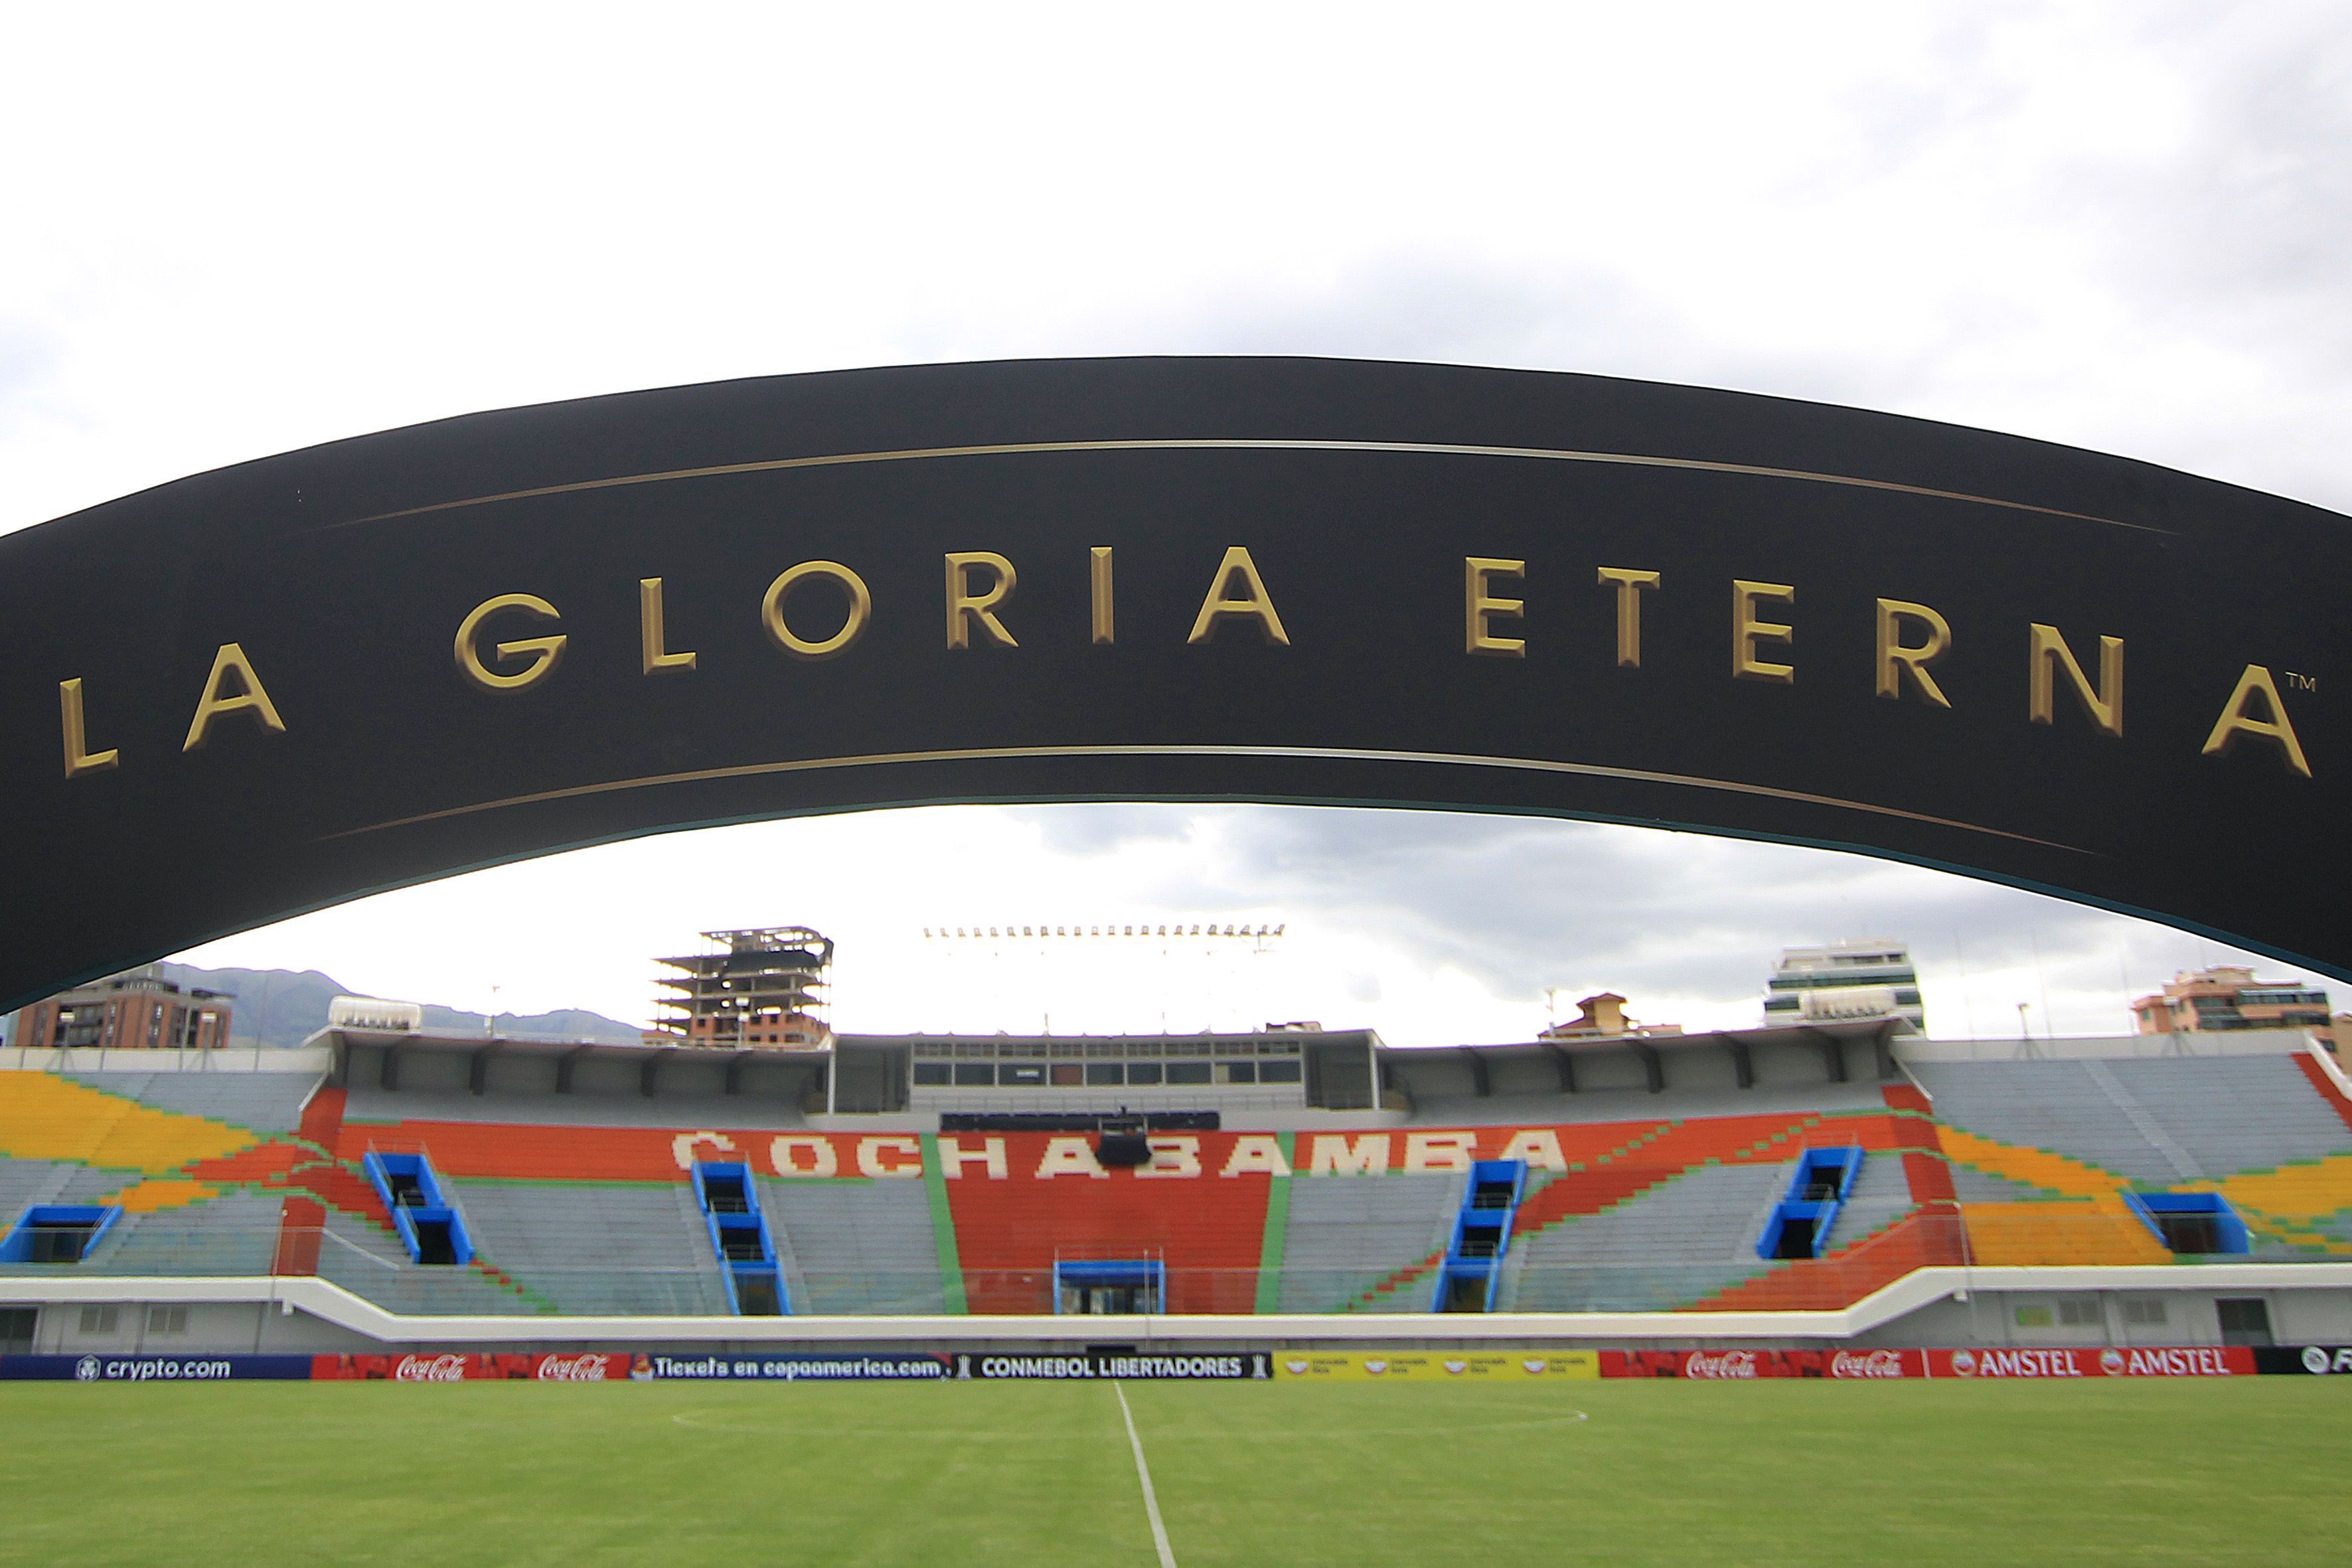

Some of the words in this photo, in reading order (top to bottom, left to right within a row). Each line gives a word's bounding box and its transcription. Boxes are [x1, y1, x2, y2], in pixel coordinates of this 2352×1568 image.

[59, 642, 286, 779] LA
[454, 545, 1291, 689] GLORIA
[1465, 556, 2313, 779] ETERNA
[671, 1129, 1569, 1180] COCHABAMBA
[105, 1357, 231, 1381] crypto.com
[653, 1356, 730, 1378] Tickets
[733, 1359, 760, 1378] en
[762, 1356, 941, 1381] copaamerica.com
[981, 1356, 1095, 1378] CONMEBOL
[1098, 1356, 1243, 1378] LIBERTADORES
[1979, 1349, 2082, 1377] AMSTEL
[2127, 1348, 2232, 1376] AMSTEL
